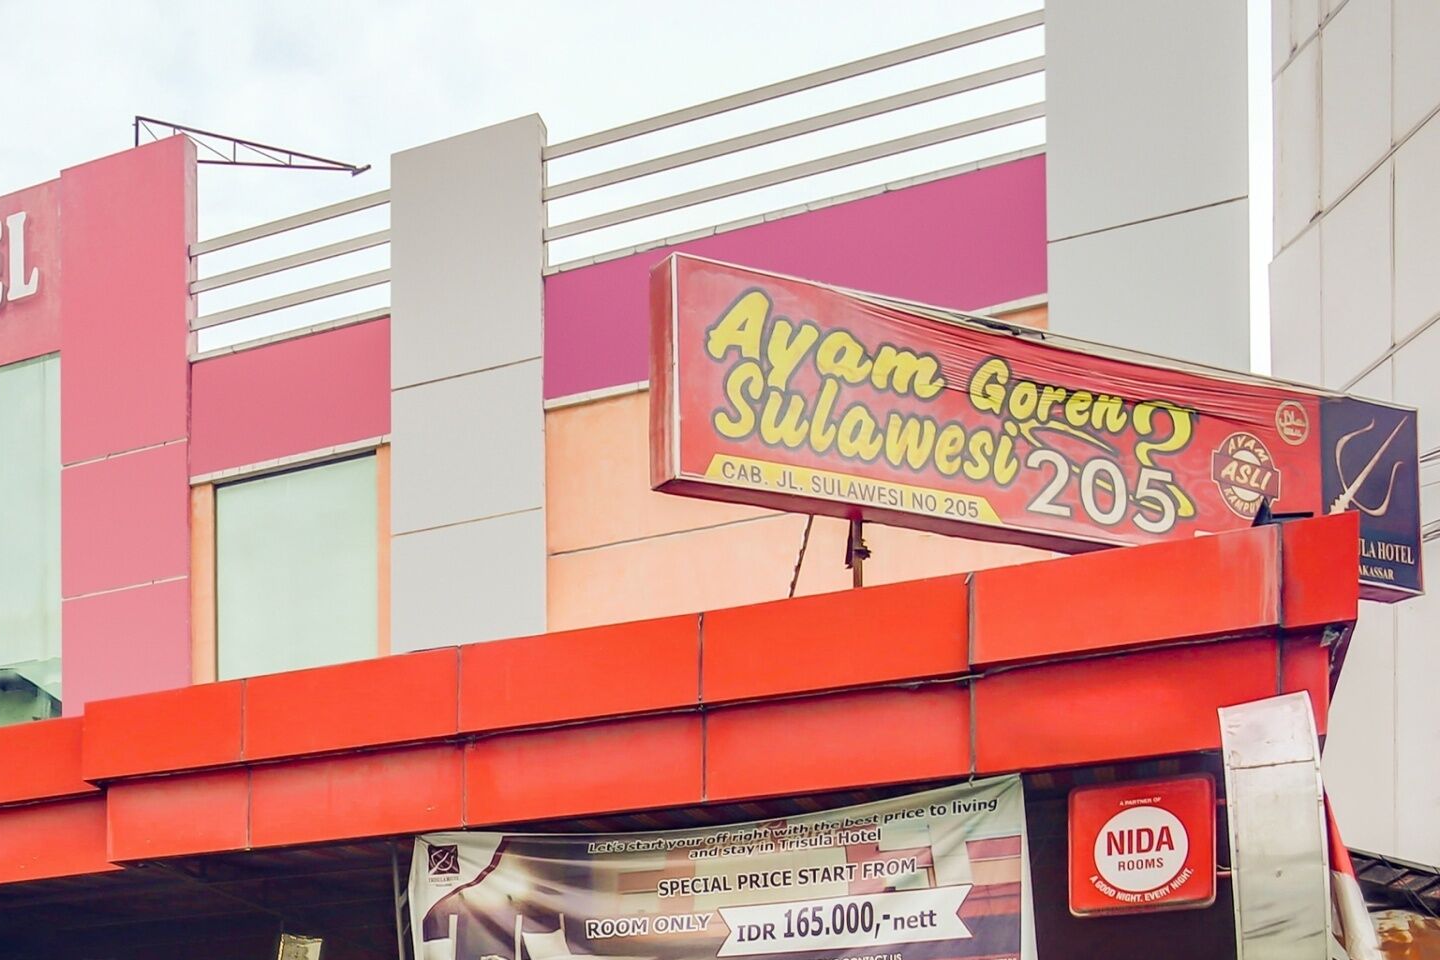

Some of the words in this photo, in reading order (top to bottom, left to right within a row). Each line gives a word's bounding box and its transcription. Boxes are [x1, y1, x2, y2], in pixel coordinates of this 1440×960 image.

[707, 290, 946, 399] Ayam
[714, 362, 1018, 486] Sulawesi
[1027, 449, 1176, 533] 205
[1228, 435, 1269, 463] AYAM
[722, 461, 768, 486] CAB.
[776, 470, 804, 491] JL.
[811, 476, 904, 507] SULAWESI
[912, 490, 937, 512] NO
[944, 497, 979, 518] 205
[1220, 460, 1272, 491] ASLI
[1377, 541, 1414, 564] HOTEL
[1124, 798, 1152, 806] PARTNER
[589, 841, 624, 853] Let's
[627, 840, 664, 851] start
[668, 838, 702, 850] your
[707, 833, 729, 844] off
[733, 829, 769, 844] right
[772, 823, 809, 837] with
[814, 820, 840, 831] the
[844, 814, 879, 828] best
[884, 807, 925, 824] price
[930, 803, 947, 816] to
[952, 799, 998, 816] living
[1106, 825, 1175, 857] NIDA
[689, 848, 718, 859] and
[723, 842, 755, 856] stay
[760, 841, 773, 851] in
[779, 832, 833, 850] Trisula
[838, 828, 882, 845] Hotel
[658, 876, 733, 897] SPECIAL
[737, 870, 792, 890] PRICE
[798, 864, 857, 885] START
[862, 858, 916, 879] FROM
[1117, 857, 1164, 872] ROOMS
[1089, 875, 1098, 884] A
[1094, 881, 1116, 897] GOOD
[1144, 887, 1171, 902] EVERY
[587, 918, 648, 937] ROOM
[654, 914, 711, 932] ONLY
[736, 922, 776, 943] IDR
